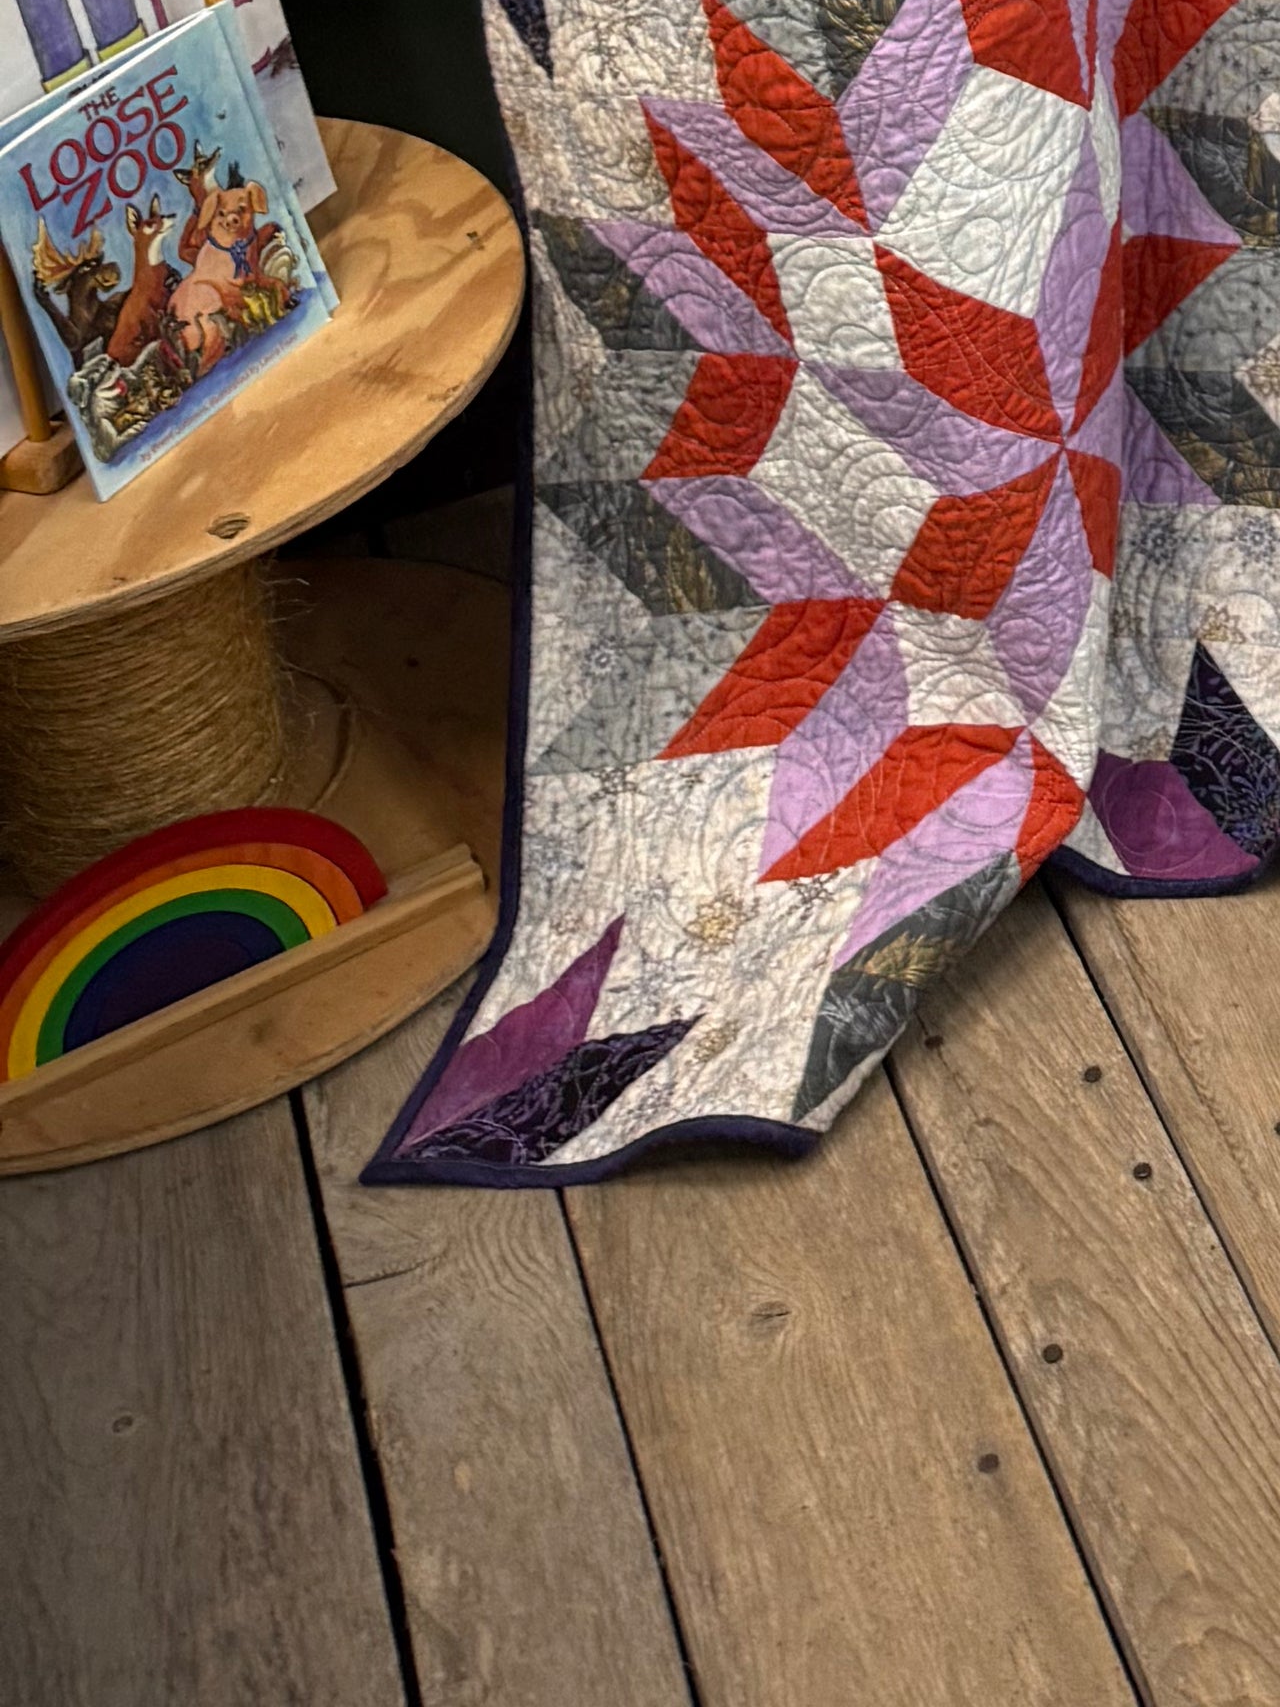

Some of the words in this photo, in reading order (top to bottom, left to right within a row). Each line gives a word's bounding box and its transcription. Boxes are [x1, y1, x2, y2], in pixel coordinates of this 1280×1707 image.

[17, 64, 190, 212] LOOSE
[77, 86, 121, 121] THE
[61, 121, 187, 239] ZOO
